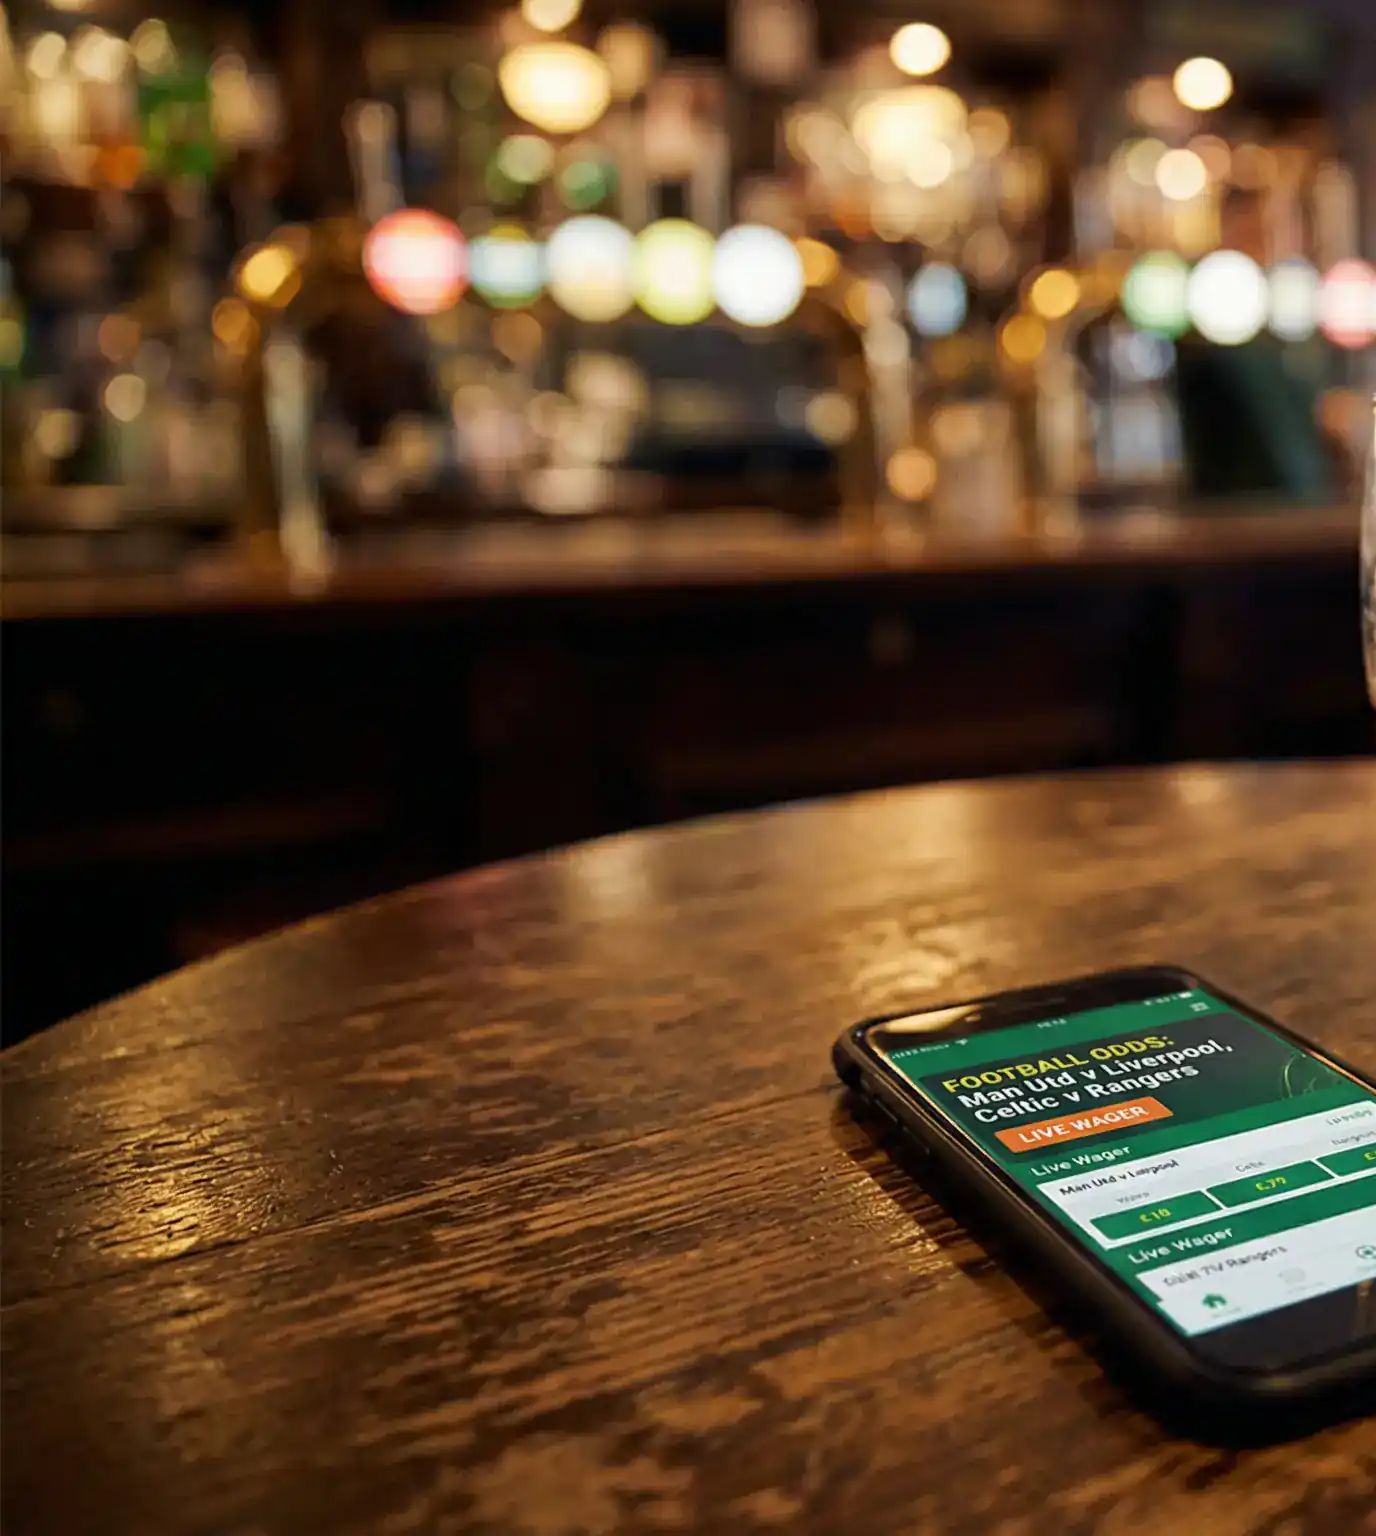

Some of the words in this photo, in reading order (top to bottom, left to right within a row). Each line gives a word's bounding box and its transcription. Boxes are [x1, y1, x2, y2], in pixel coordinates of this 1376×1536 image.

[942, 1051, 1090, 1094] FOOTBALL
[1089, 1034, 1176, 1061] ODDS:
[957, 1084, 1024, 1109] Man
[1023, 1071, 1077, 1094] Utd
[1079, 1066, 1098, 1081] v
[1099, 1039, 1233, 1077] Liverpool,
[974, 1093, 1060, 1124] Celtic
[1062, 1089, 1081, 1103] v
[1083, 1063, 1200, 1099] Rangers
[1018, 1121, 1071, 1145] LIVE
[1069, 1105, 1149, 1132] WAGER
[1031, 1160, 1072, 1177] Live
[1072, 1145, 1131, 1167] Wager
[1059, 1180, 1091, 1197] Man
[1128, 1246, 1171, 1264] Live
[1171, 1228, 1234, 1251] Wager
